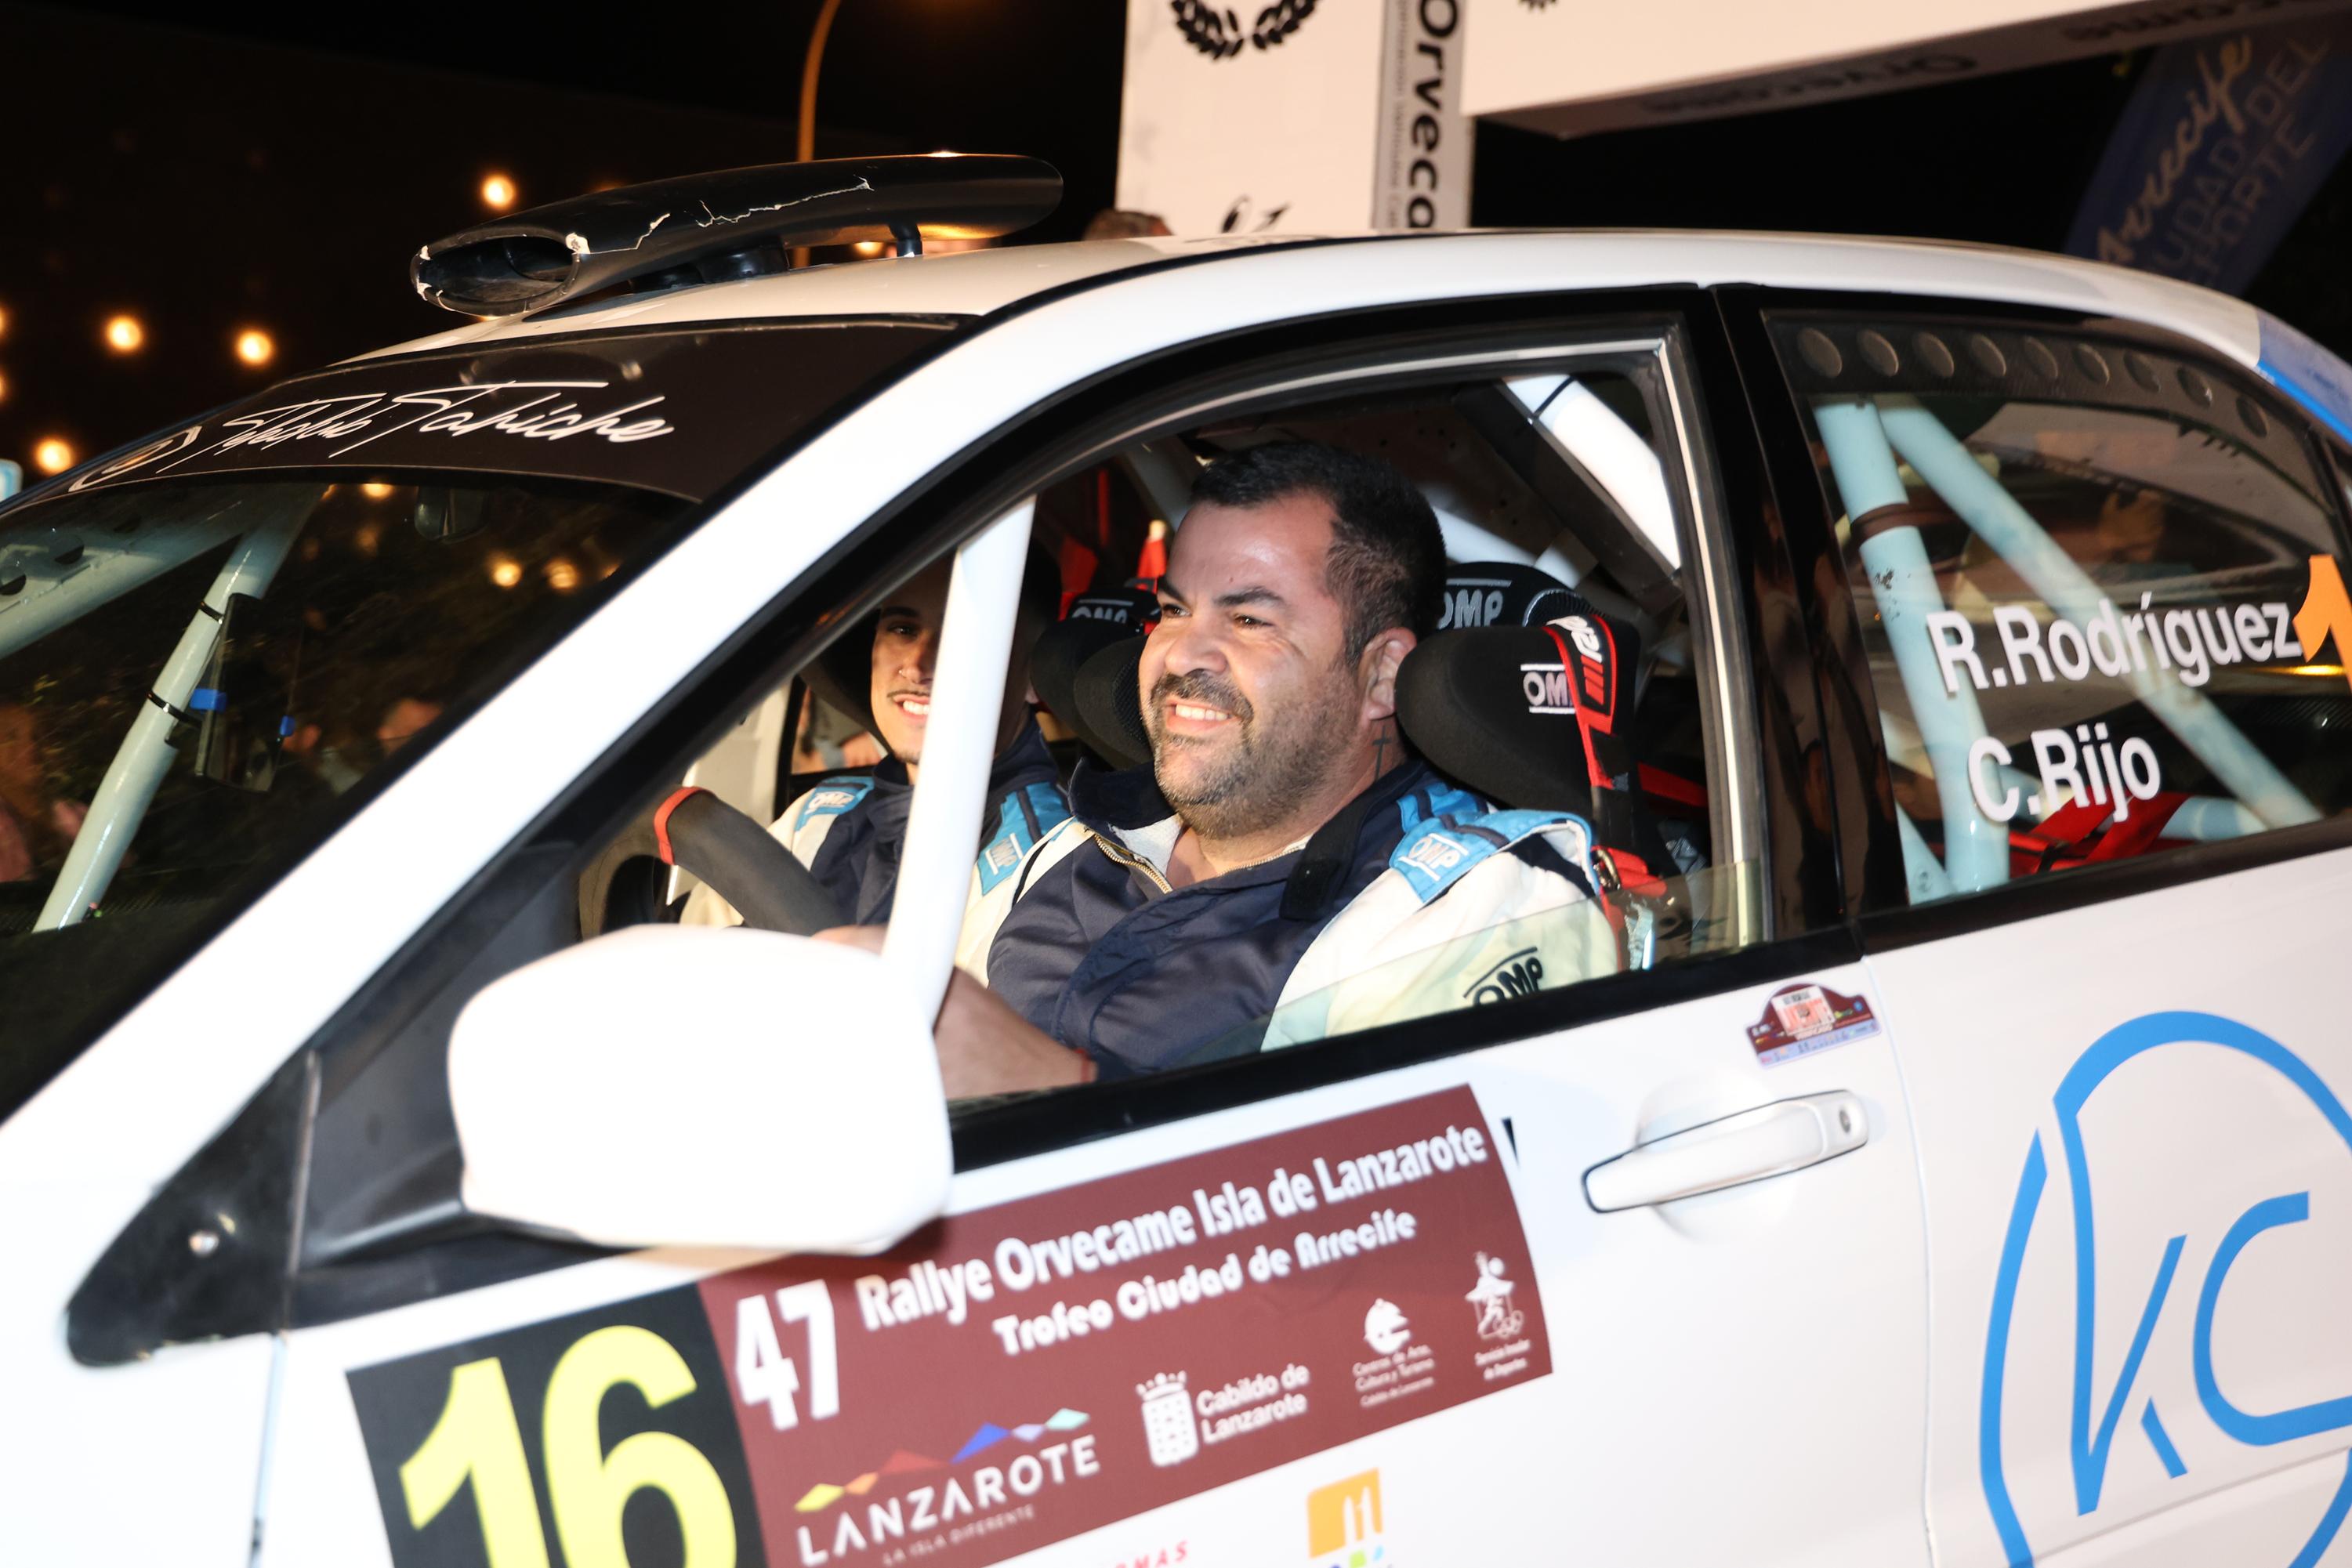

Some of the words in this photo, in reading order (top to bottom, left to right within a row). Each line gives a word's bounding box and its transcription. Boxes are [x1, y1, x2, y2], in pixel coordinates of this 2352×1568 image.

[328, 381, 675, 457] Tahiche
[1926, 592, 2303, 693] R.Rodríguez
[1522, 672, 1572, 706] OM
[1968, 722, 2160, 822] C.Rijo
[1408, 837, 1460, 870] OMP
[1473, 957, 1543, 1006] OMP
[854, 1258, 995, 1331] Rallye
[994, 1204, 1197, 1291] Orvecame
[1193, 1182, 1267, 1237] Isla
[1268, 1168, 1317, 1218] de
[1313, 1125, 1488, 1204] Lanzarote
[992, 1298, 1114, 1356] Trofeo
[1116, 1253, 1244, 1320] Ciudad
[1248, 1244, 1292, 1283] de
[1293, 1208, 1417, 1269] Arrecife
[735, 1280, 840, 1430] 47
[1196, 1373, 1279, 1416] Cabildo
[1281, 1363, 1310, 1390] de
[399, 1325, 737, 1568] 16
[1201, 1393, 1308, 1444] Lanzarote
[797, 1434, 1100, 1567] LANZAROTE
[950, 1504, 1035, 1543] DIFERENTE
[1115, 1540, 1187, 1568] MAS
